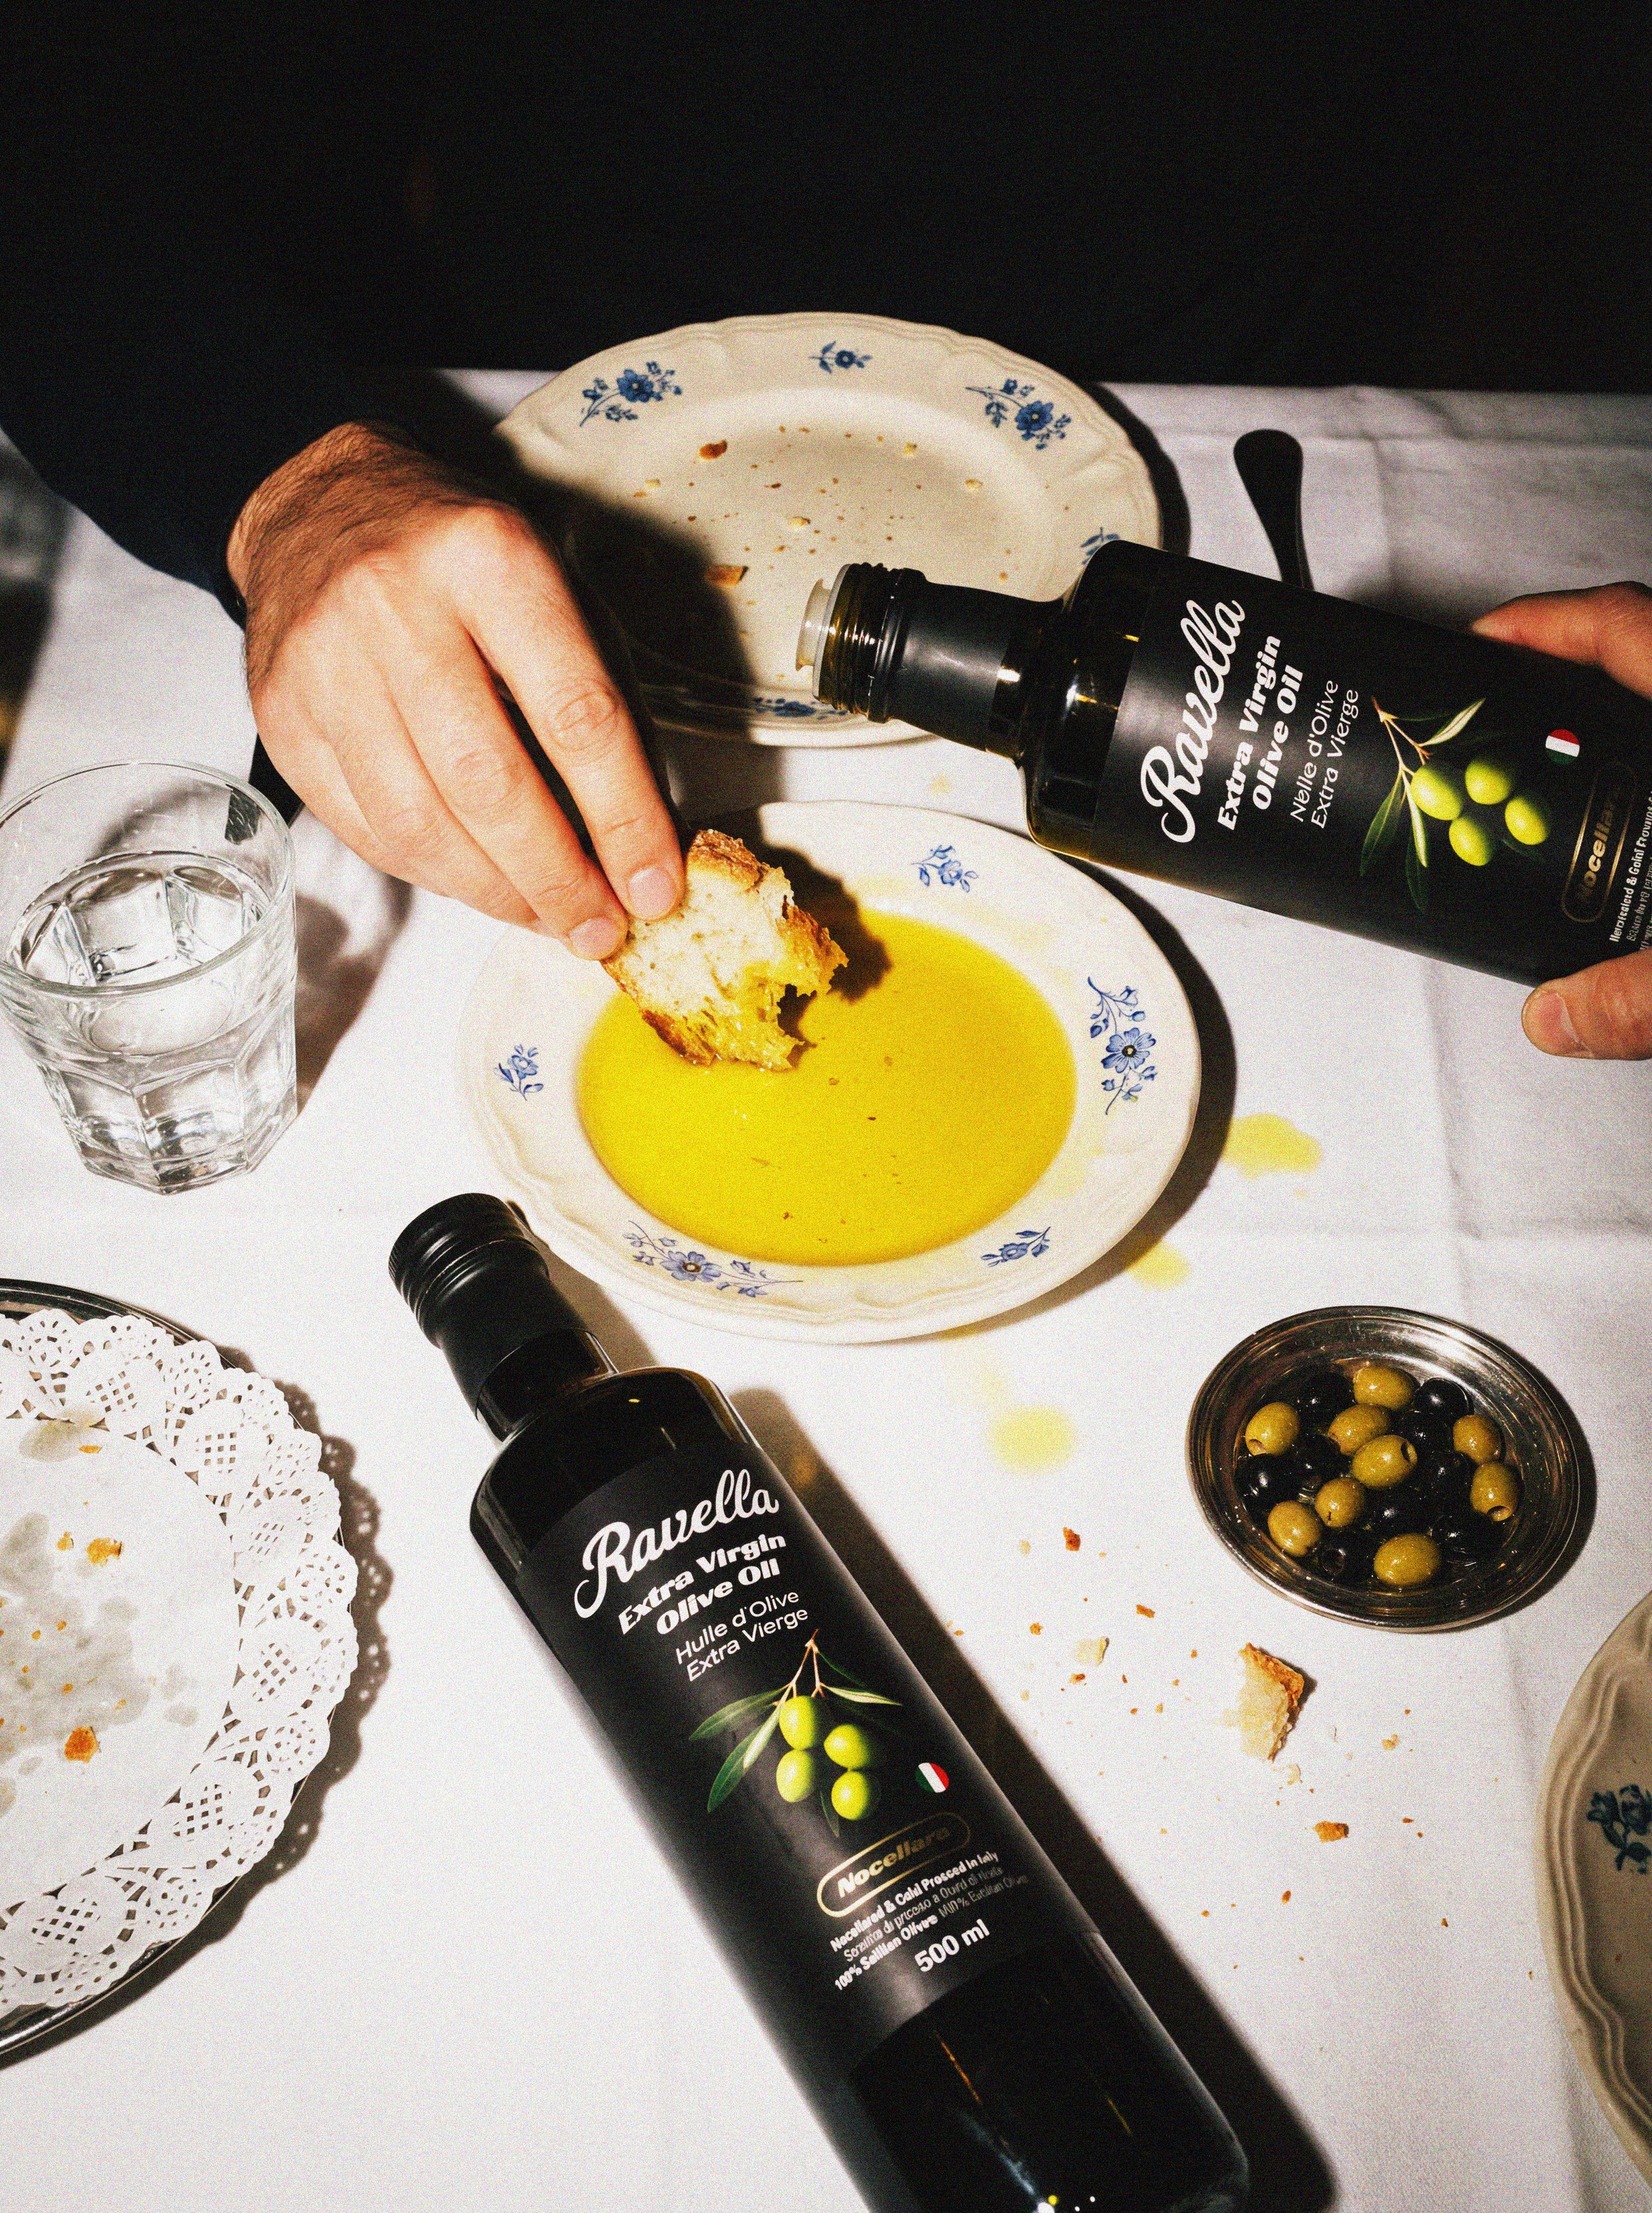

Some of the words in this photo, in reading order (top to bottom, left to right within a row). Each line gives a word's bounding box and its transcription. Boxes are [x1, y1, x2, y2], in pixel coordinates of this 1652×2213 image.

[1140, 600, 1246, 843] Ravella
[1217, 741, 1254, 831] Extra
[1238, 635, 1281, 732] Virgin
[1252, 720, 1289, 810] Olive
[1277, 664, 1304, 715] Oil
[1306, 680, 1339, 757] d'Olive
[1311, 769, 1339, 829] Extra
[1327, 689, 1359, 758] Vierge
[574, 1469, 780, 1618] Ravella
[617, 1571, 695, 1635] Extra
[696, 1533, 787, 1573] Virgin
[656, 1580, 733, 1635] Olive
[687, 1641, 741, 1682] Extra
[742, 1608, 809, 1643] Vierge
[732, 1591, 800, 1628] d'Olive
[884, 1900, 897, 1914] &
[914, 1935, 959, 1972] 500
[961, 1918, 991, 1947] ml
